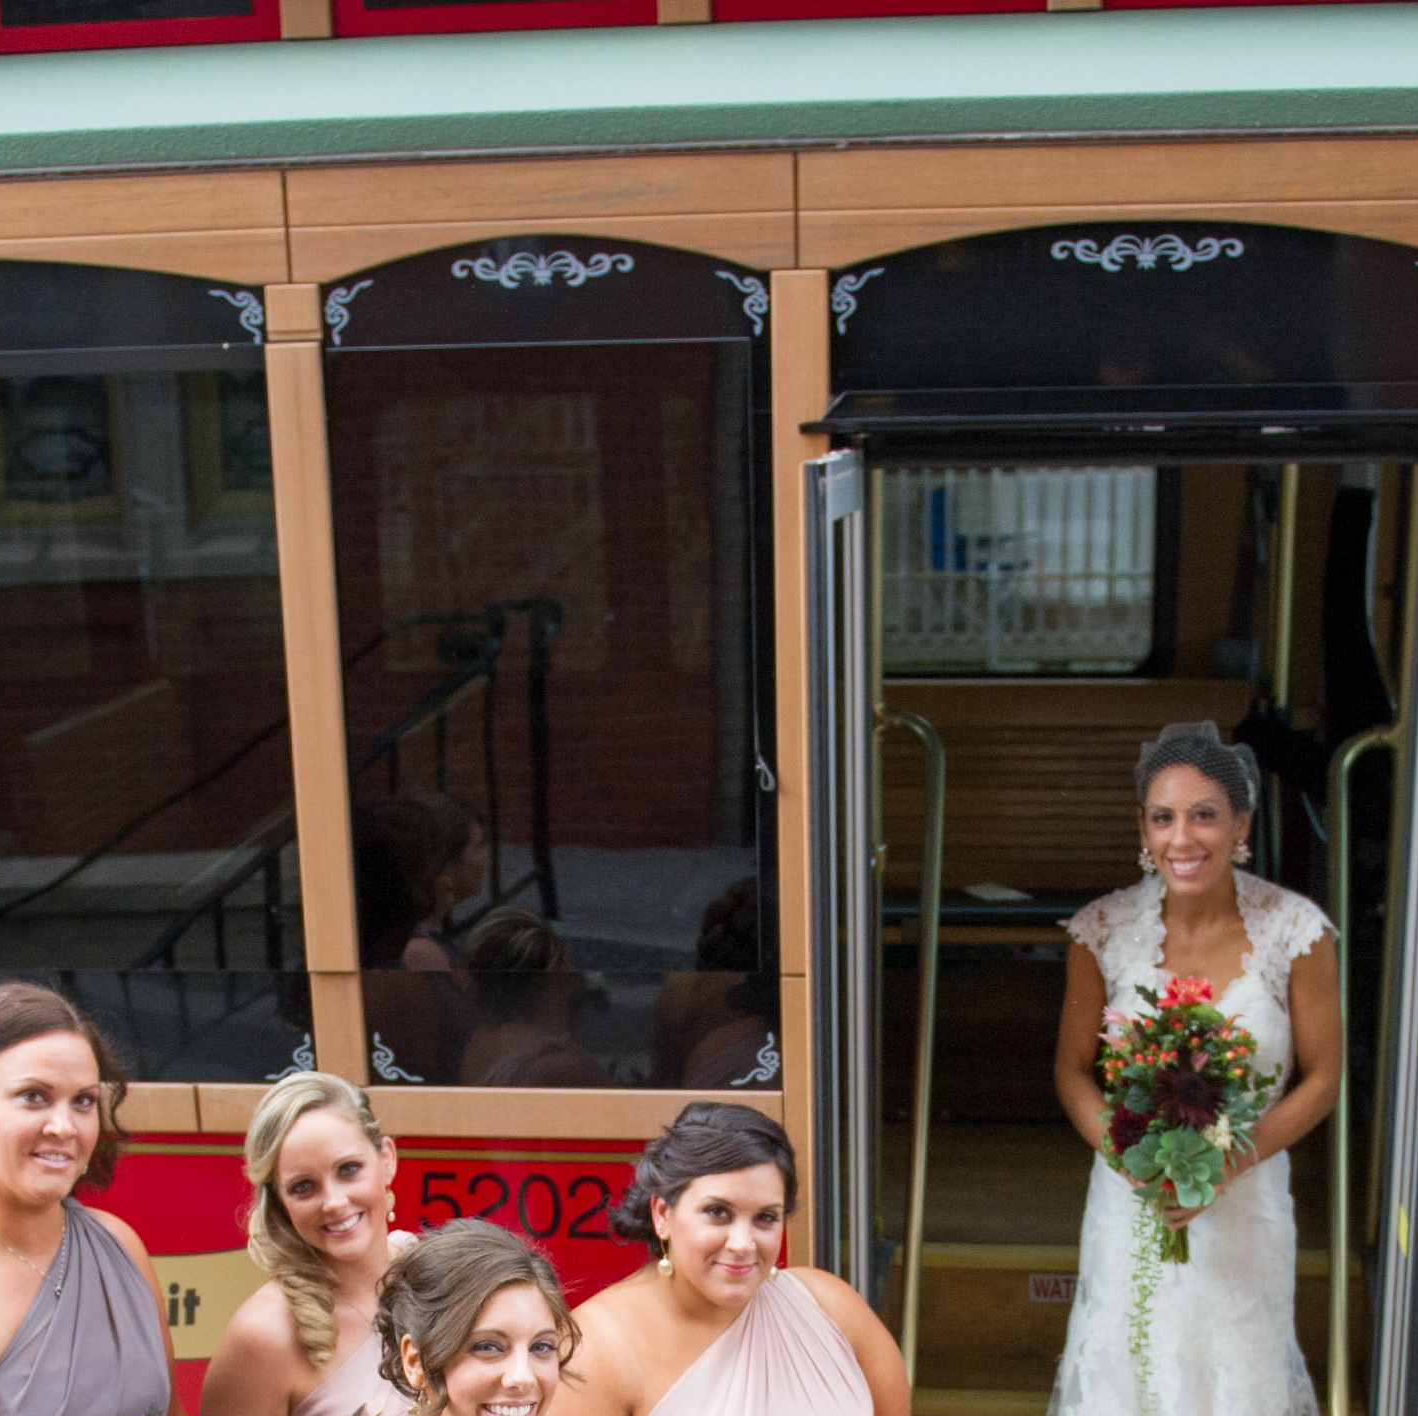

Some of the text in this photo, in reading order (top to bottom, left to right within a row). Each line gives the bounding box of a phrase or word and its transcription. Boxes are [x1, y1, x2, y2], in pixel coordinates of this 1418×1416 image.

[419, 1171, 612, 1239] 5202
[168, 1282, 201, 1326] it
[1032, 1277, 1076, 1300] WAT
